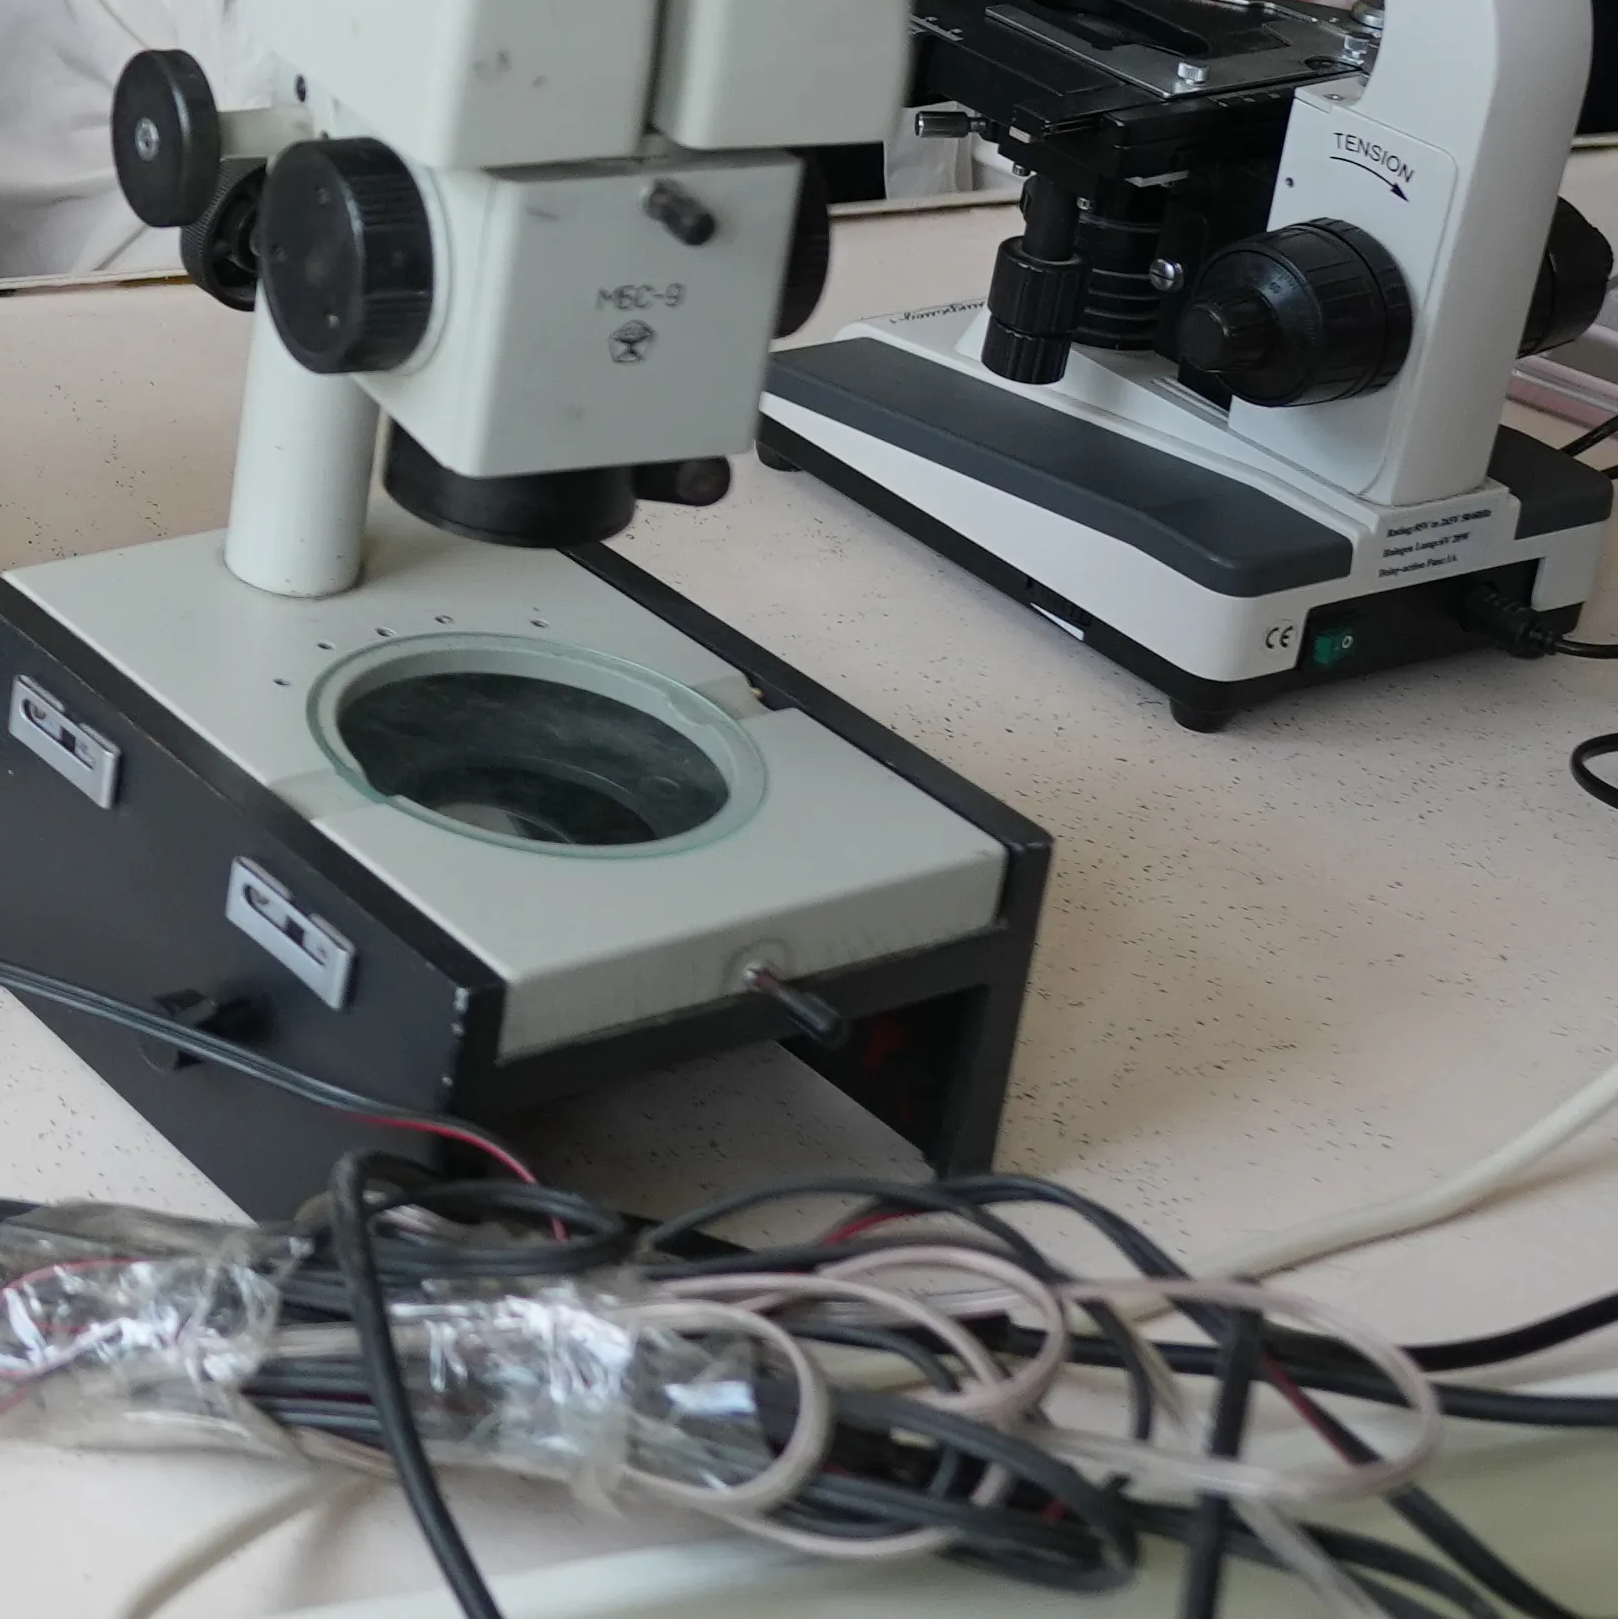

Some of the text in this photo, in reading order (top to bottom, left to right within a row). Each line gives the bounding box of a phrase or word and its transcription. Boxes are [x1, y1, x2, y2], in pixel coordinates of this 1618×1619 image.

[1332, 132, 1416, 183] TENSION
[595, 283, 686, 311] МБС-9
[1266, 624, 1294, 650] CE
